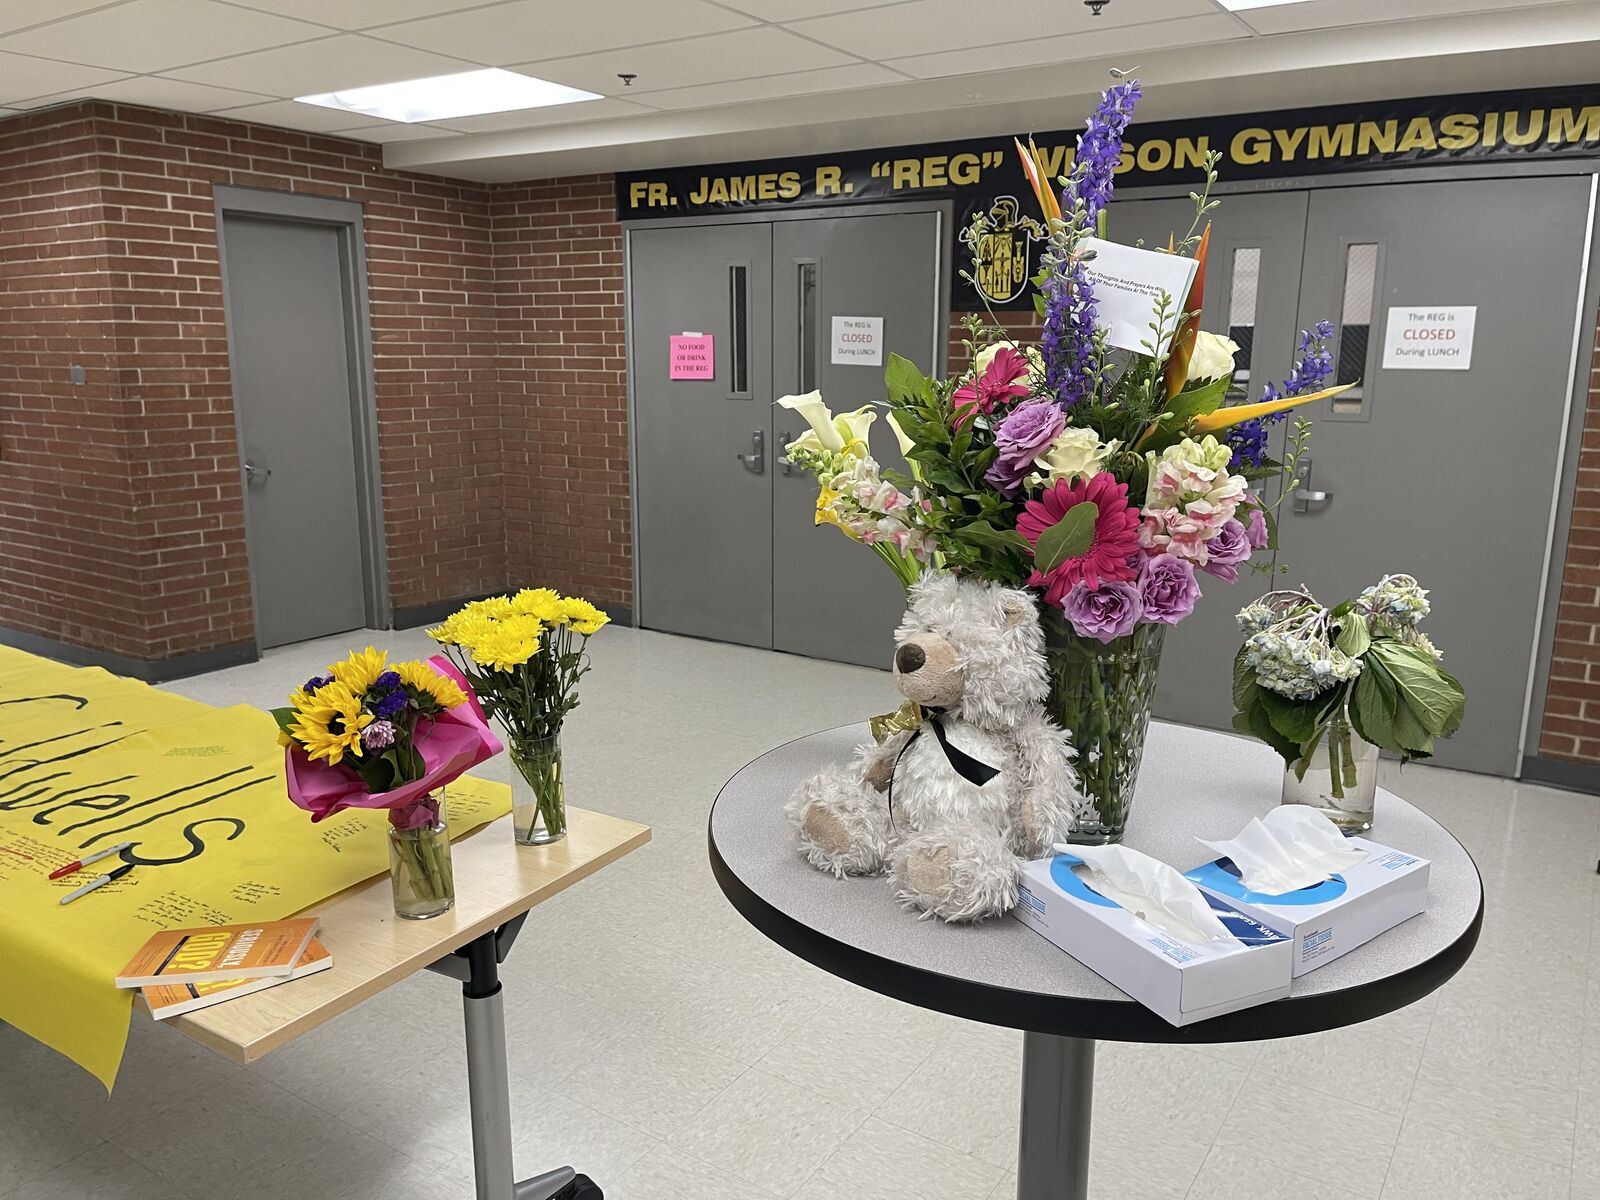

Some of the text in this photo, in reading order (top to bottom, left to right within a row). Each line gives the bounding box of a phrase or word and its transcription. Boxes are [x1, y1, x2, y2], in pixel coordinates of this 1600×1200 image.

[629, 105, 1600, 208] FR. JAMES R. “REG” WISON GYMNASIUM
[1097, 272, 1119, 282] Thoughts
[1129, 280, 1146, 289] Prayers
[1113, 283, 1133, 292] Families
[1408, 313, 1455, 321] The REG is
[854, 321, 866, 329] REG
[866, 321, 872, 329] is
[841, 333, 873, 343] CLOSED
[1403, 328, 1456, 340] CLOSED
[838, 347, 876, 356] During LUNCH
[1395, 347, 1460, 357] During LUNCH
[166, 931, 233, 970] GOD?
[217, 928, 264, 969] SERIOUSLY,
